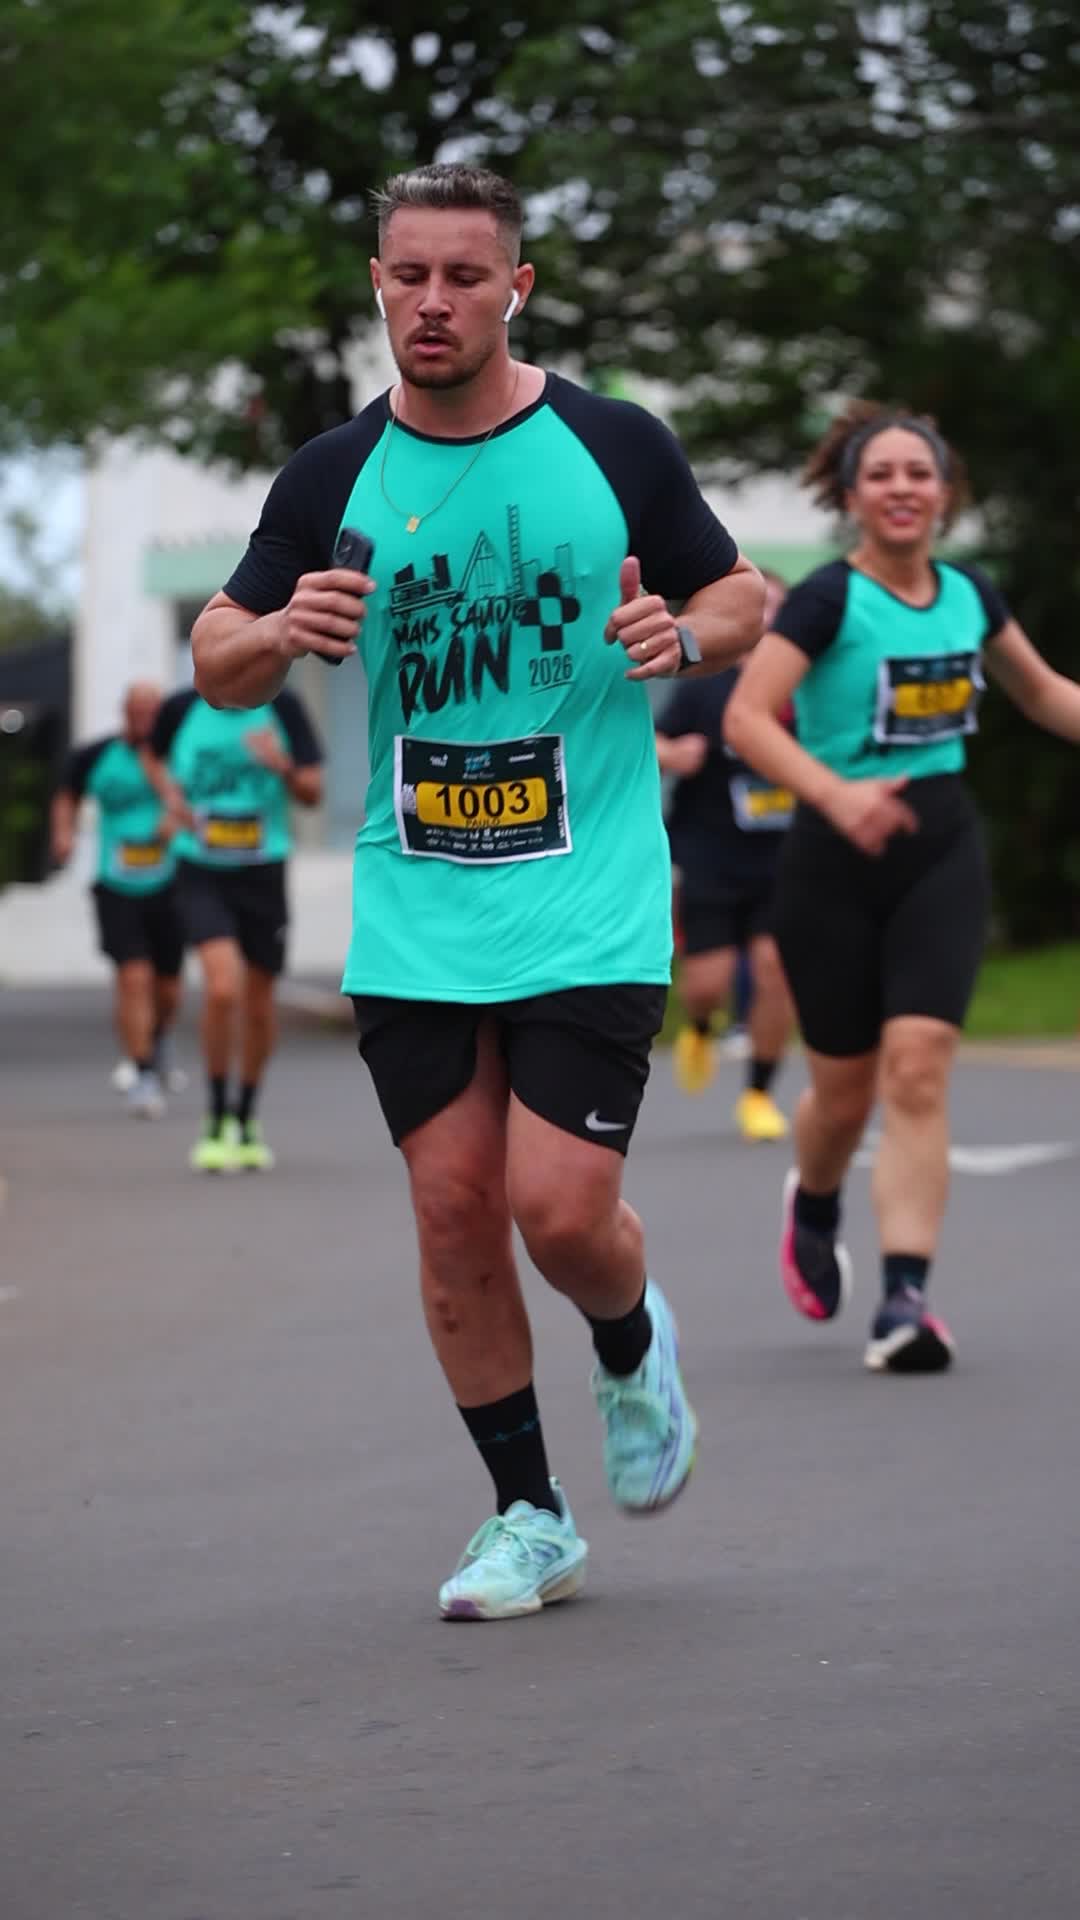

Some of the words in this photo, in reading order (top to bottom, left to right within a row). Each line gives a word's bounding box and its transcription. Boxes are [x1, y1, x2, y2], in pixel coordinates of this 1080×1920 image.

[393, 613, 440, 651] MAIS
[399, 624, 512, 726] RUN
[529, 654, 573, 686] 2026
[436, 782, 529, 818] 1003
